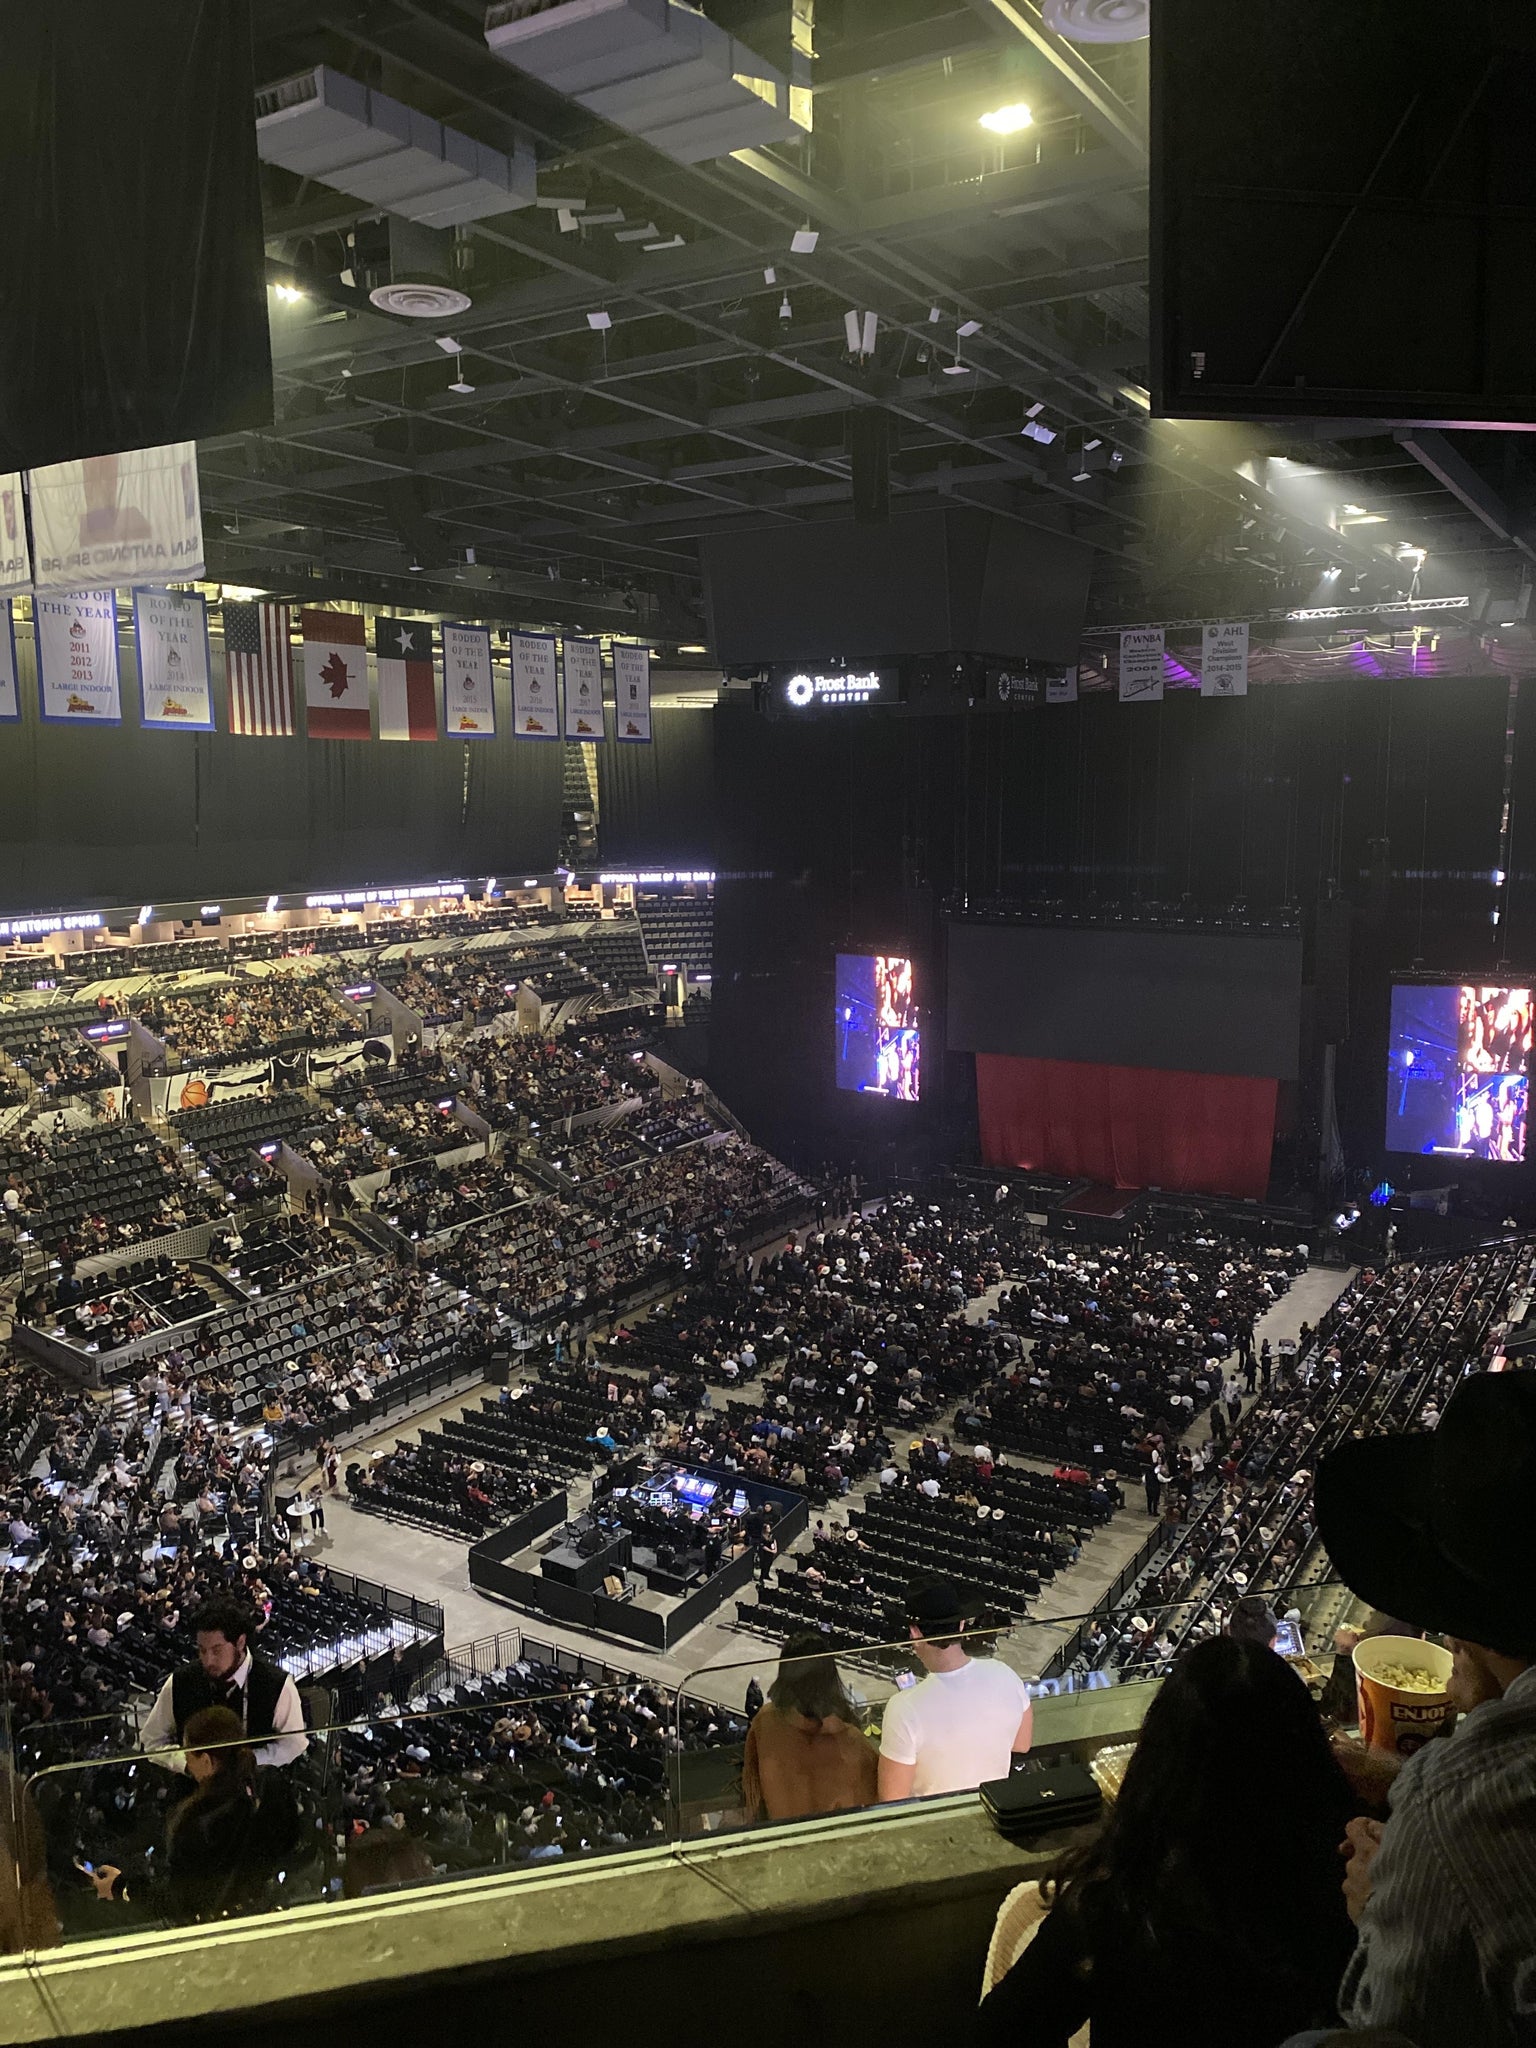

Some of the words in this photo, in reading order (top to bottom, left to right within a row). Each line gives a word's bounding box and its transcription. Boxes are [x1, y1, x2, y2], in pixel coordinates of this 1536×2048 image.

[93, 591, 111, 602] OF
[40, 601, 71, 616] THE
[75, 606, 111, 619] YEAR
[150, 614, 167, 626] OF
[168, 616, 194, 628] THE
[1224, 626, 1244, 636] AHL
[159, 631, 188, 644] YEAR
[1133, 634, 1161, 643] WNBA
[69, 641, 90, 653] 2011
[70, 656, 92, 667] 2012
[71, 669, 93, 681] 2013
[51, 682, 79, 692] LARGE
[80, 684, 113, 693] INDOOR
[814, 675, 846, 692] Frost
[846, 671, 880, 690] Bank
[822, 692, 869, 702] CENTER
[11, 918, 62, 934] ANTONIO
[63, 915, 100, 929] SPURS
